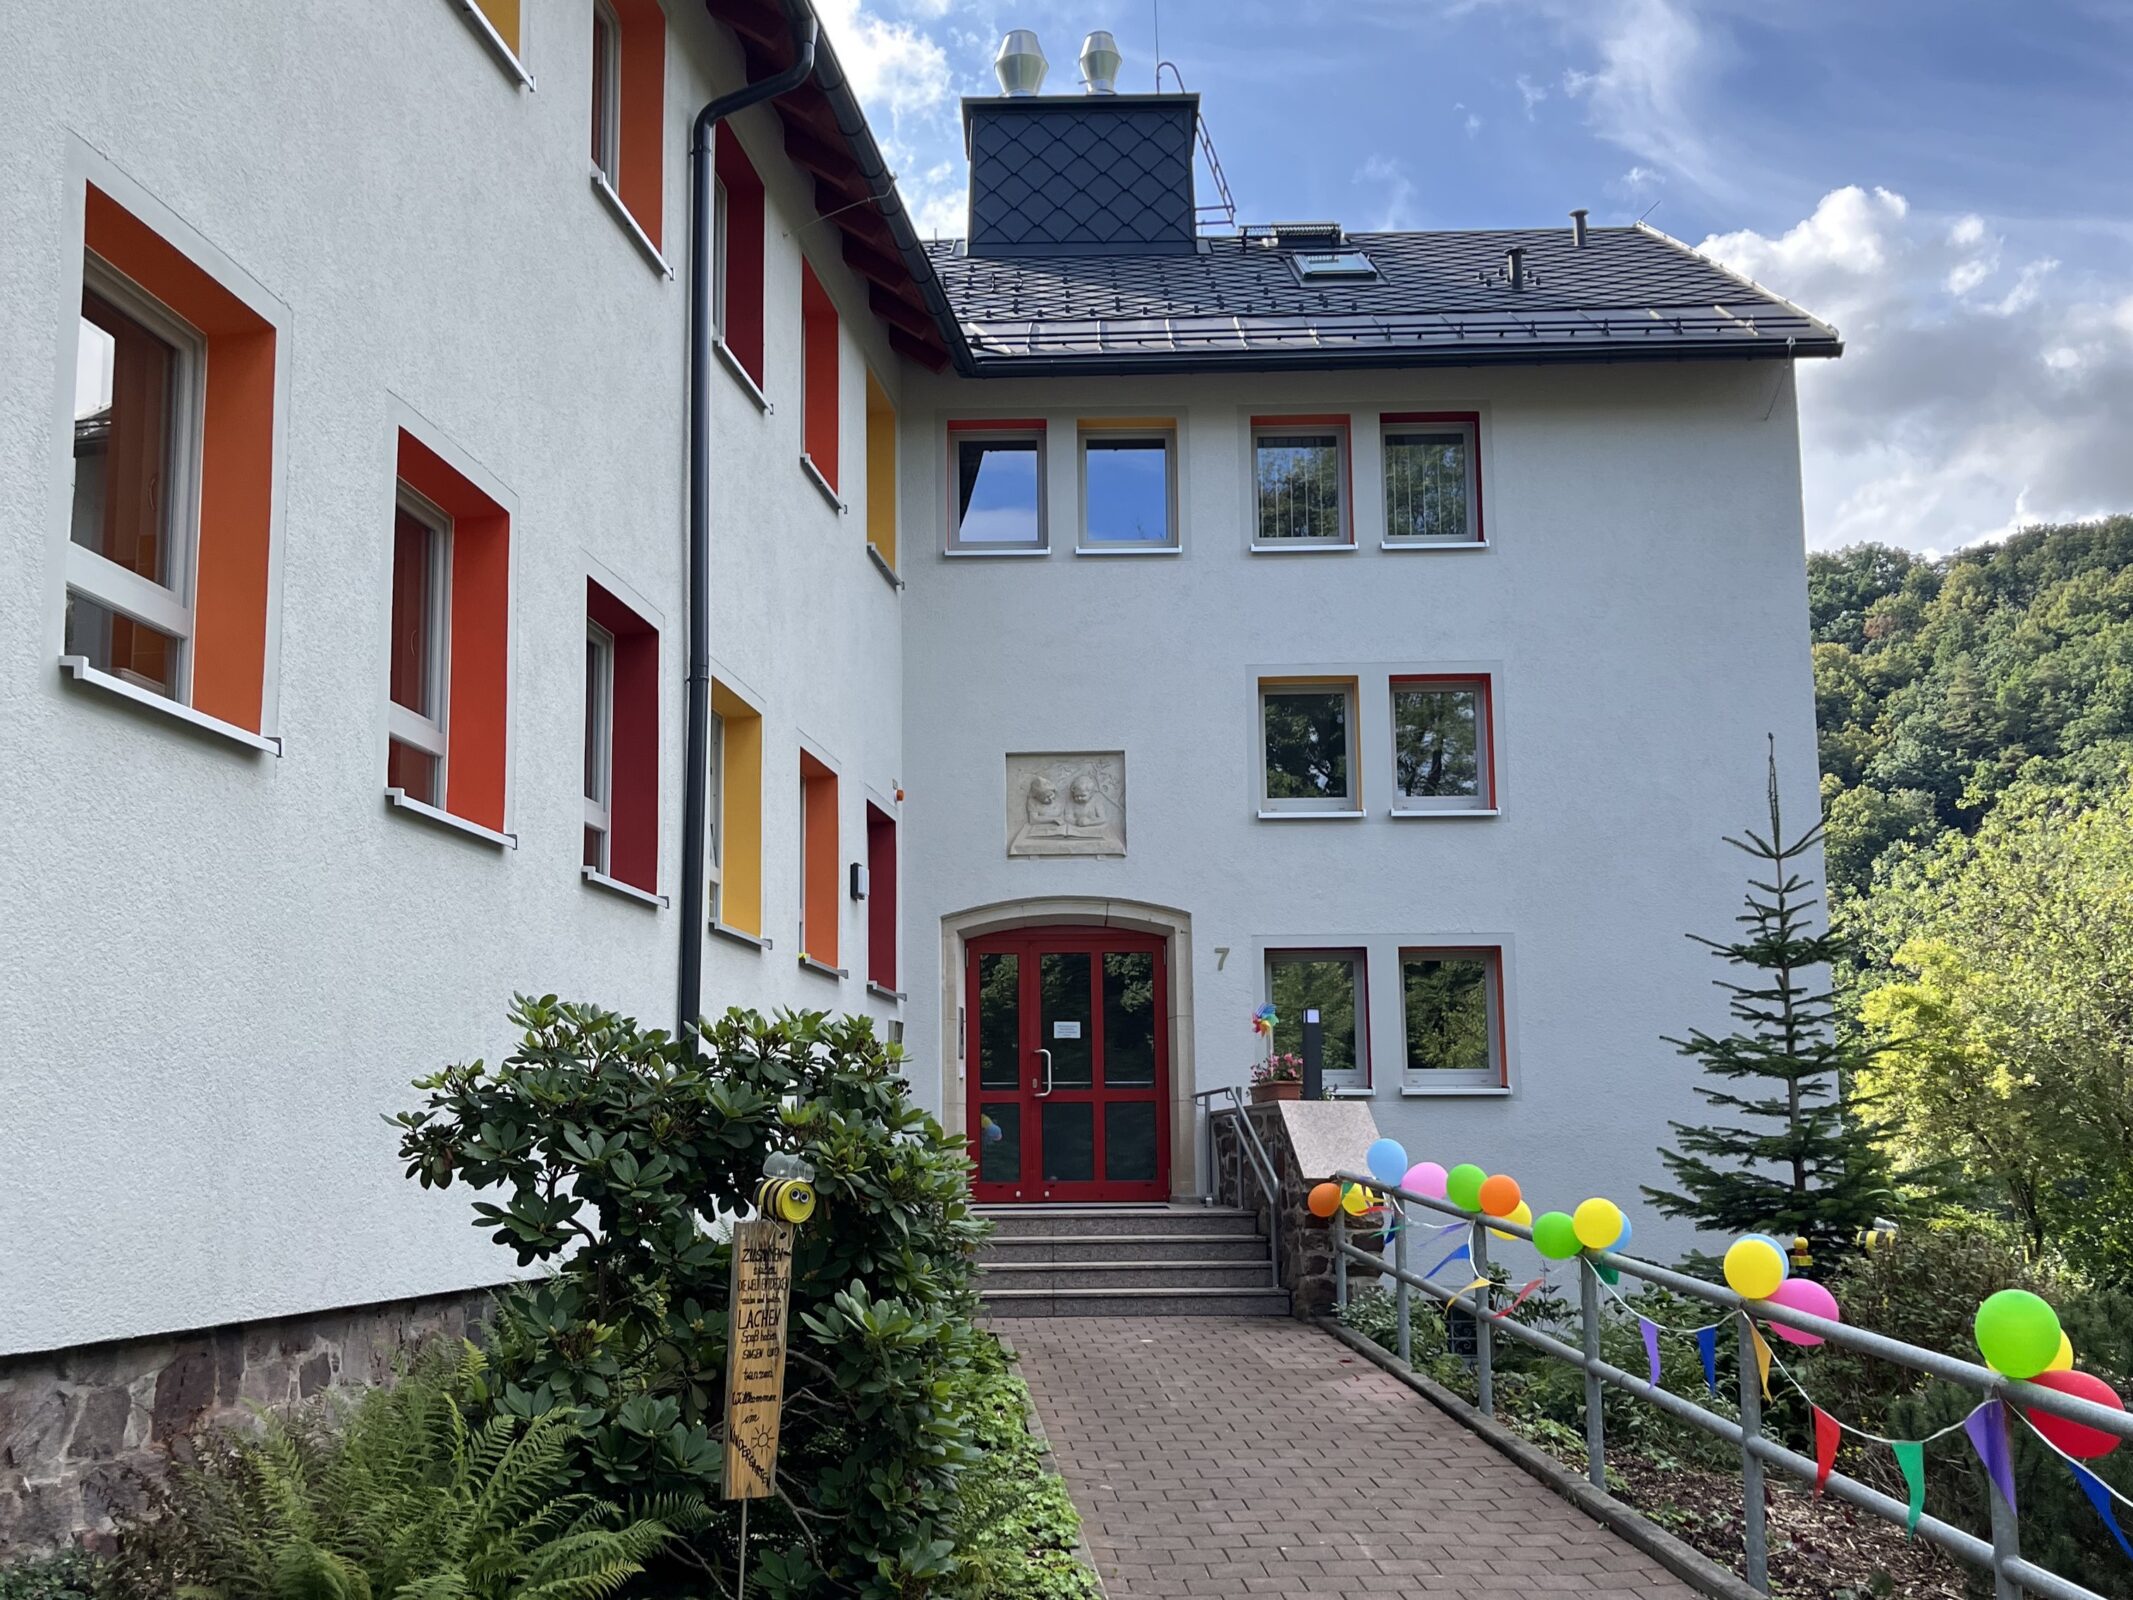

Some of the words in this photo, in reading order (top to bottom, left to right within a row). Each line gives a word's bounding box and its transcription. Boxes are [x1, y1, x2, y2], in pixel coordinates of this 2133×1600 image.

[1214, 948, 1230, 971] 7
[738, 1308, 781, 1329] LACHEN
[741, 1329, 759, 1347] Spaß
[743, 1368, 774, 1381] tanzen
